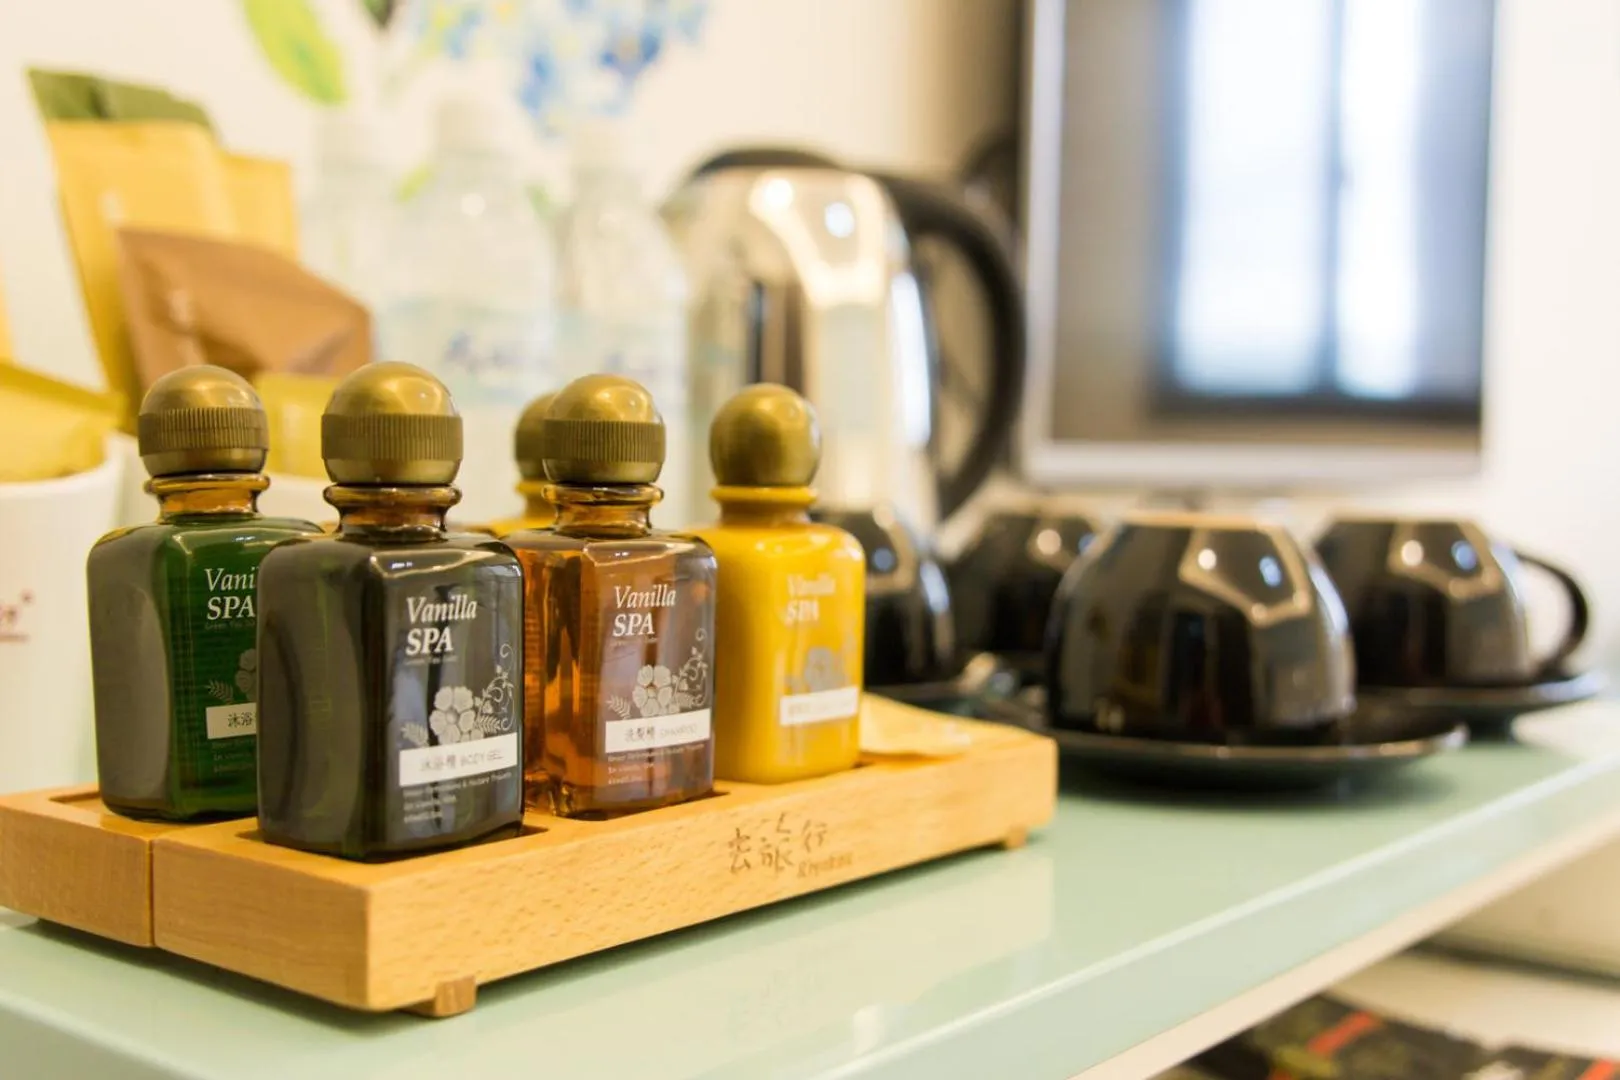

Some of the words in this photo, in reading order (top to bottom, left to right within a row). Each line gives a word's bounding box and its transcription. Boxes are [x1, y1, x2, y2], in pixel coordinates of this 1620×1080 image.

[204, 566, 259, 592] Vani
[207, 595, 256, 620] SPA
[614, 584, 677, 609] Vanilla
[406, 594, 477, 625] Vanilla
[612, 612, 655, 637] SPA
[405, 627, 454, 656] SPA
[227, 712, 256, 729] 沐浴
